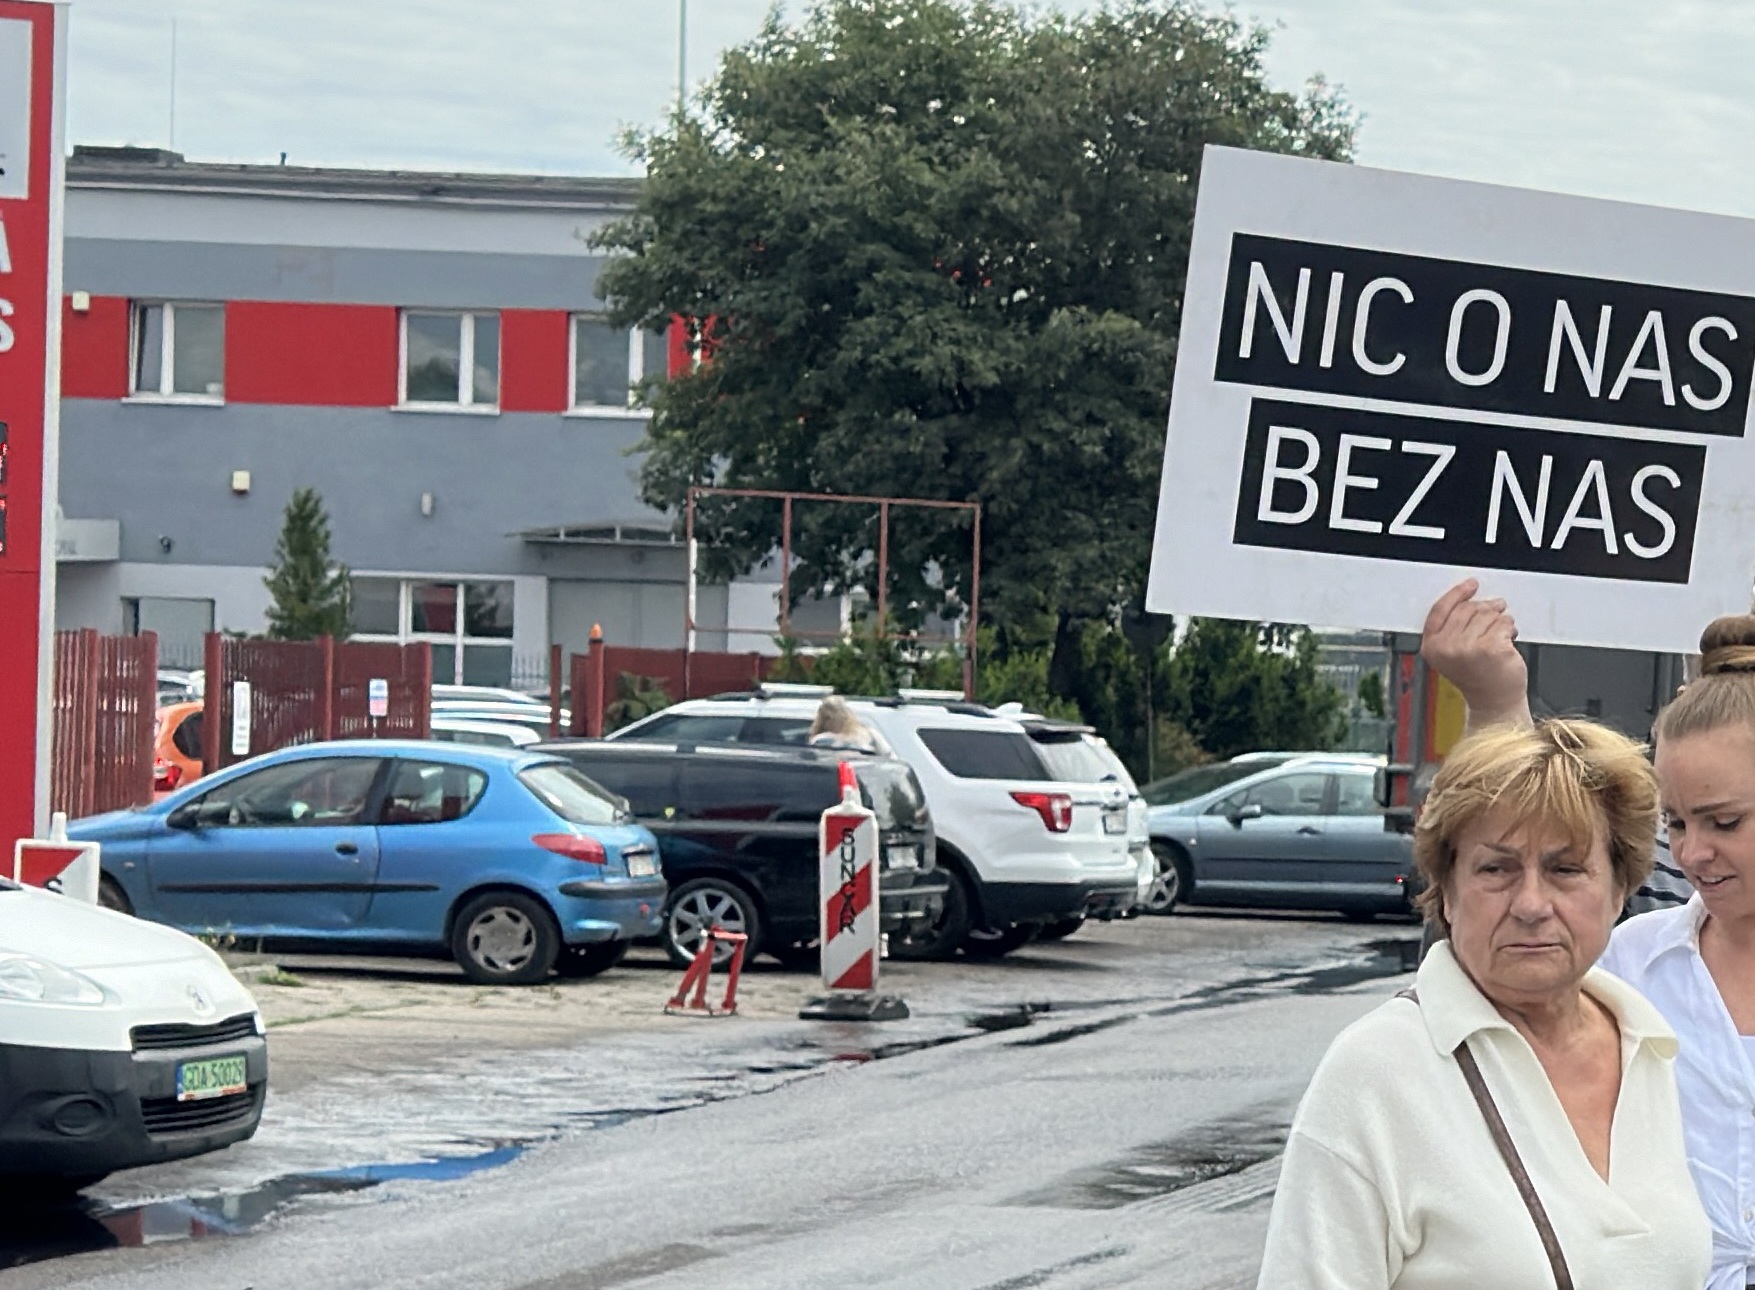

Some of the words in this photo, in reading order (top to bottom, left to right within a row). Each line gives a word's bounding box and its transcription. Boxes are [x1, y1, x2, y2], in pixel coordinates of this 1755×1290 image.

[1238, 260, 1415, 376] NIC
[1444, 288, 1512, 387] O
[1542, 299, 1739, 411] NAS
[1256, 424, 1457, 540] BEZ
[1484, 449, 1682, 560] NAS
